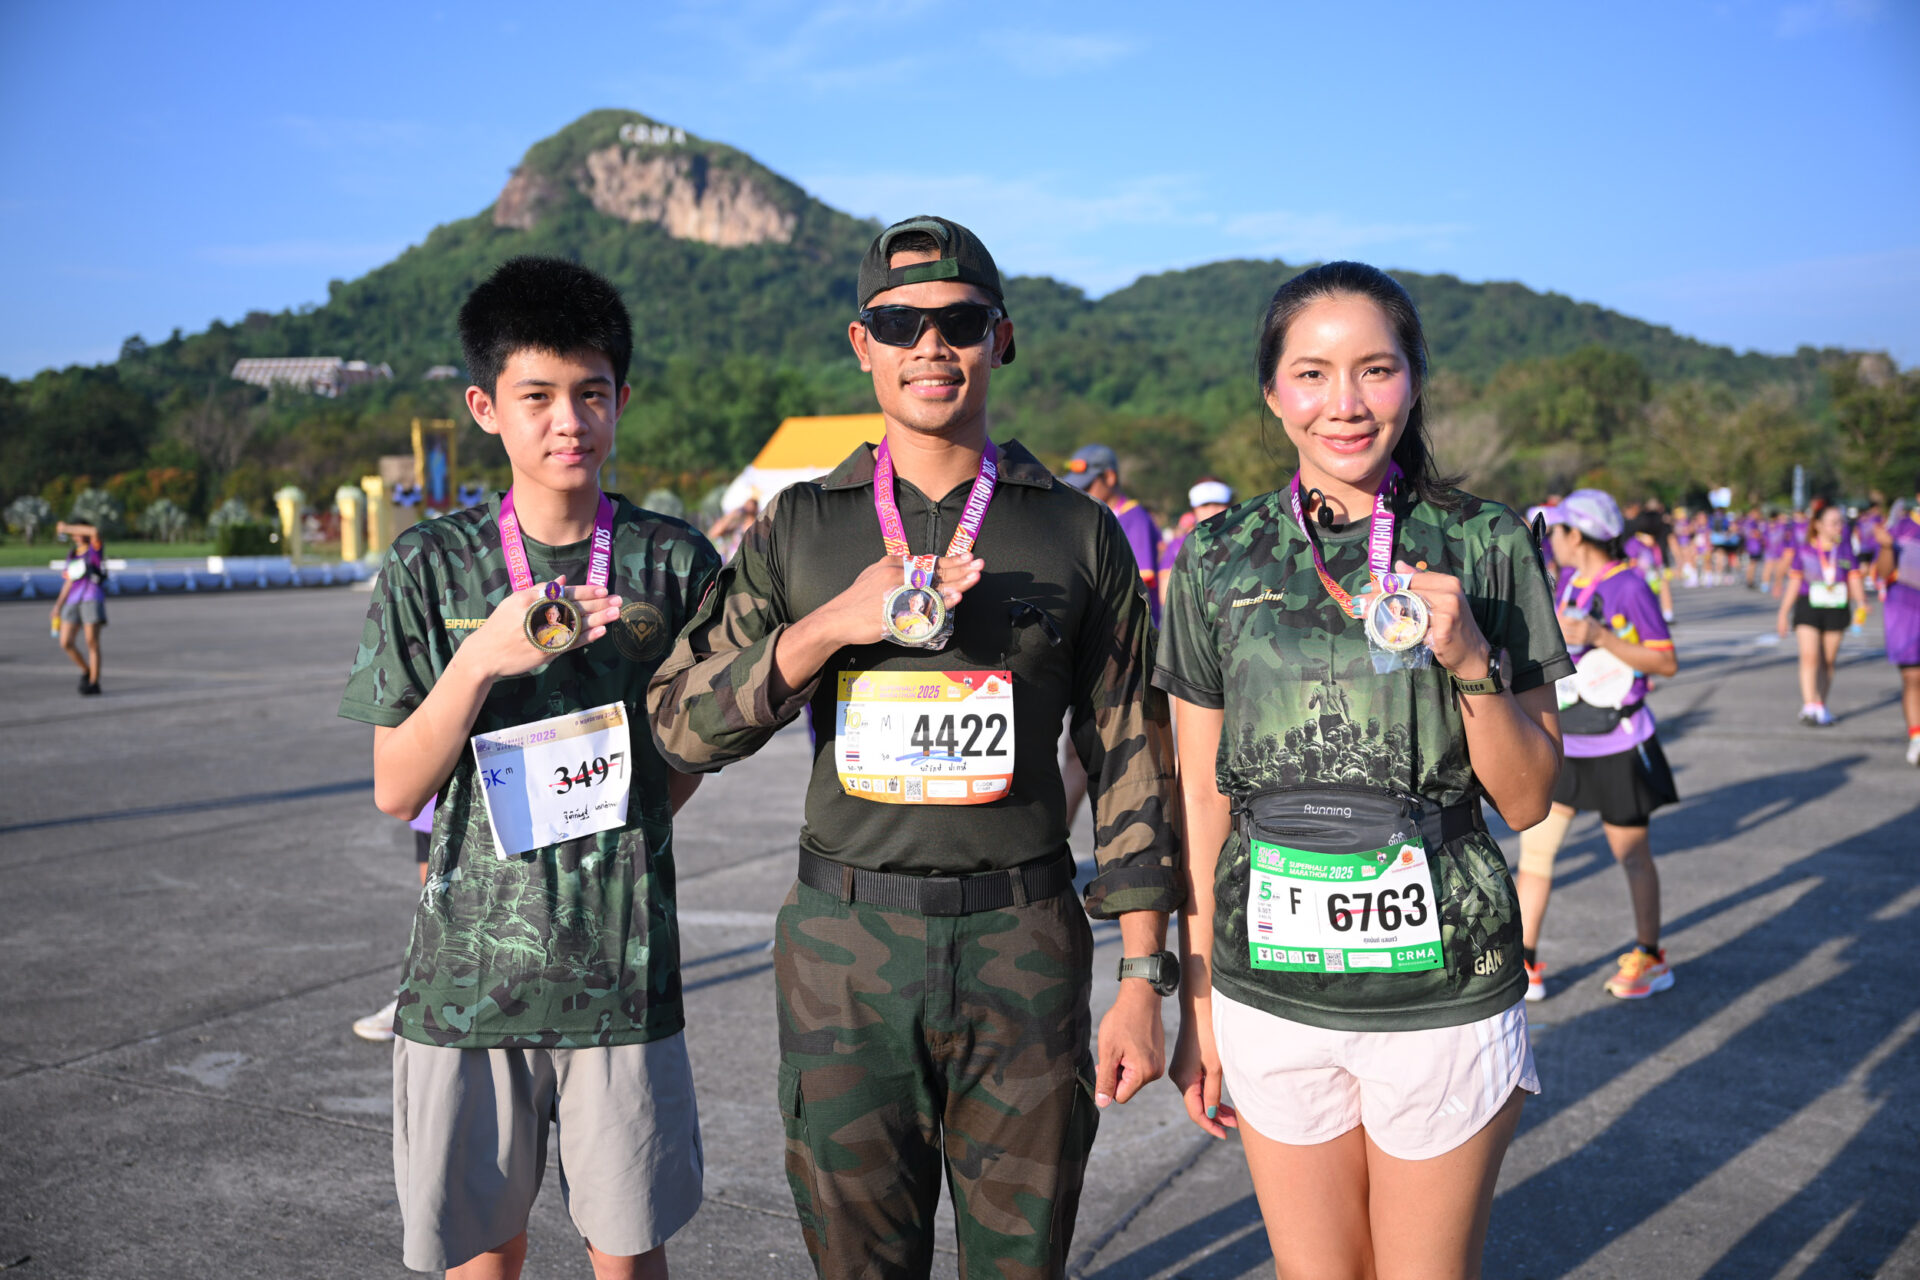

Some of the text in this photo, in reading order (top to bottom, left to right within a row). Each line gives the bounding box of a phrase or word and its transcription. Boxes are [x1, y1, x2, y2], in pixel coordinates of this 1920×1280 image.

[878, 453, 890, 477] THE
[879, 477, 903, 542] GREATEST
[960, 474, 994, 533] MARATHON
[502, 513, 518, 545] THE
[594, 526, 611, 551] 2025
[1371, 517, 1393, 577] MARATHON
[917, 685, 941, 699] 2025
[529, 729, 557, 744] 2025
[910, 713, 1008, 758] 4422
[553, 751, 625, 795] 3497
[1303, 803, 1352, 819] Running
[1289, 861, 1329, 872] SUPERHALF
[1289, 867, 1328, 879] MARATHON
[1328, 865, 1355, 879] 2025
[1258, 880, 1272, 900] 5
[1289, 886, 1302, 915] F
[1326, 882, 1428, 932] 6763
[1396, 947, 1436, 961] CRMA
